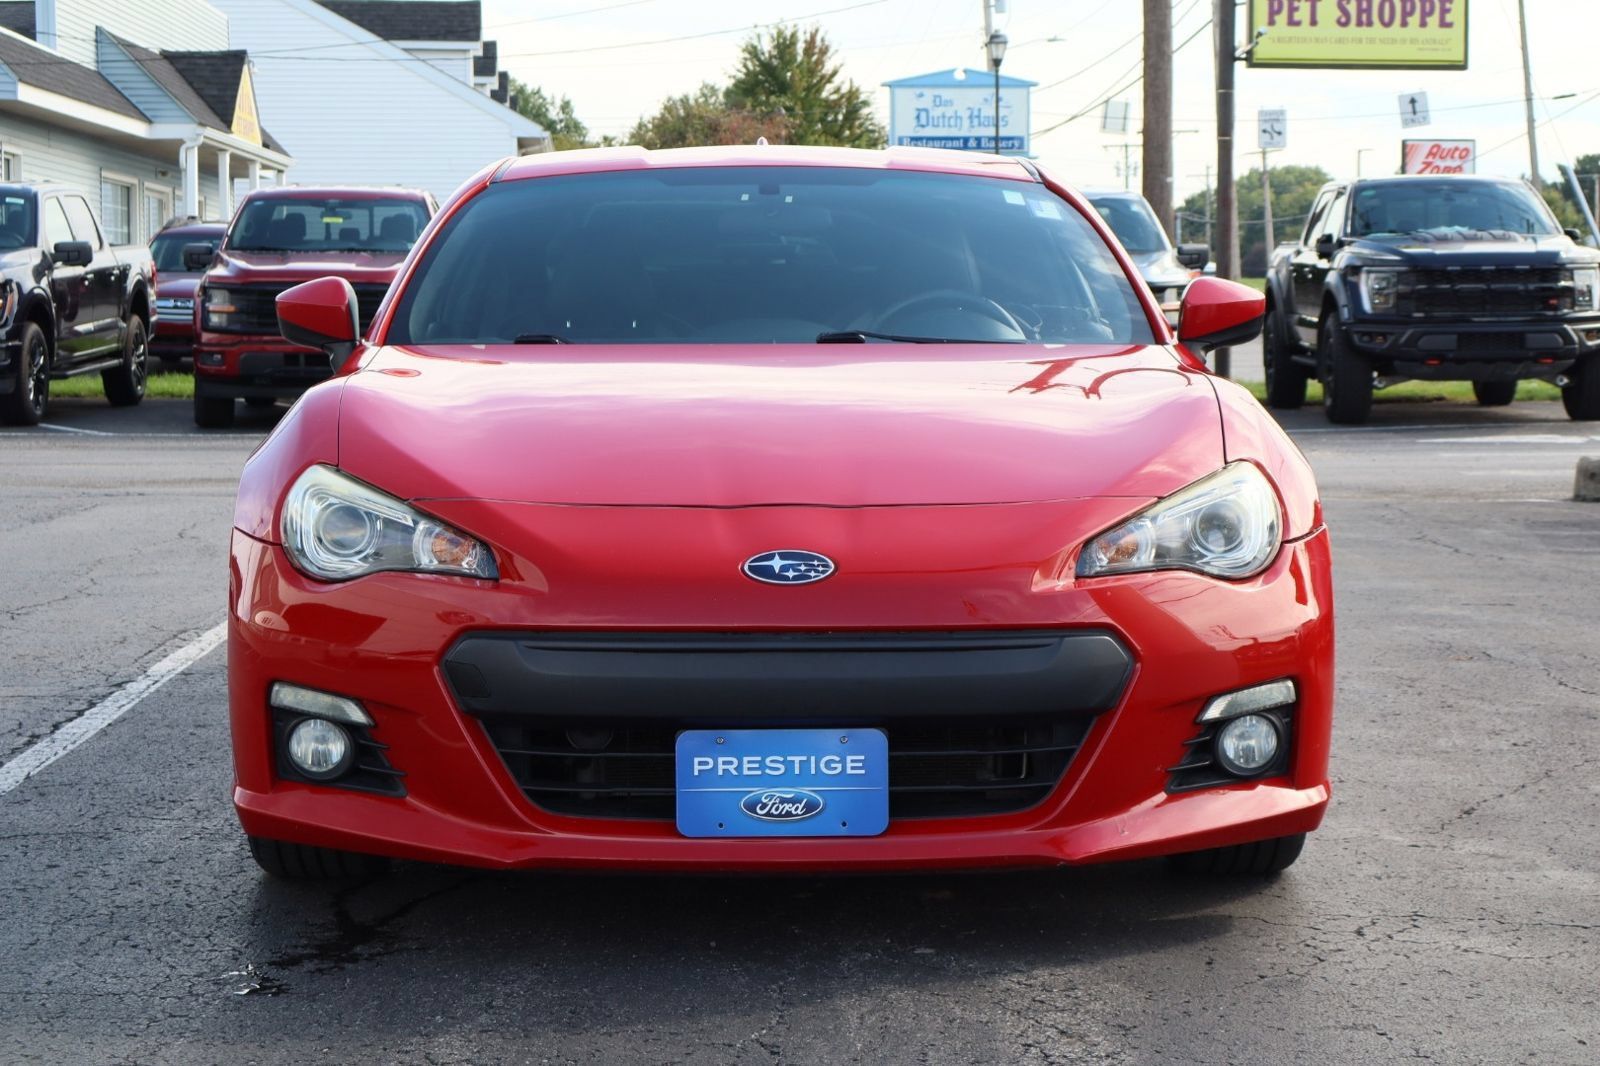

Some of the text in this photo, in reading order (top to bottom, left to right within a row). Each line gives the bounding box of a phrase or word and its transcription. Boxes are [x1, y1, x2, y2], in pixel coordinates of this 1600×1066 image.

[1267, 0, 1454, 28] PET SHOPPE
[933, 94, 953, 108] Das
[914, 107, 1009, 132] Dutch Haus
[903, 137, 964, 148] Restaurant
[967, 137, 978, 148] &
[1425, 143, 1470, 160] Auto
[693, 755, 866, 776] PRESTIGE
[756, 792, 807, 816] Ford
